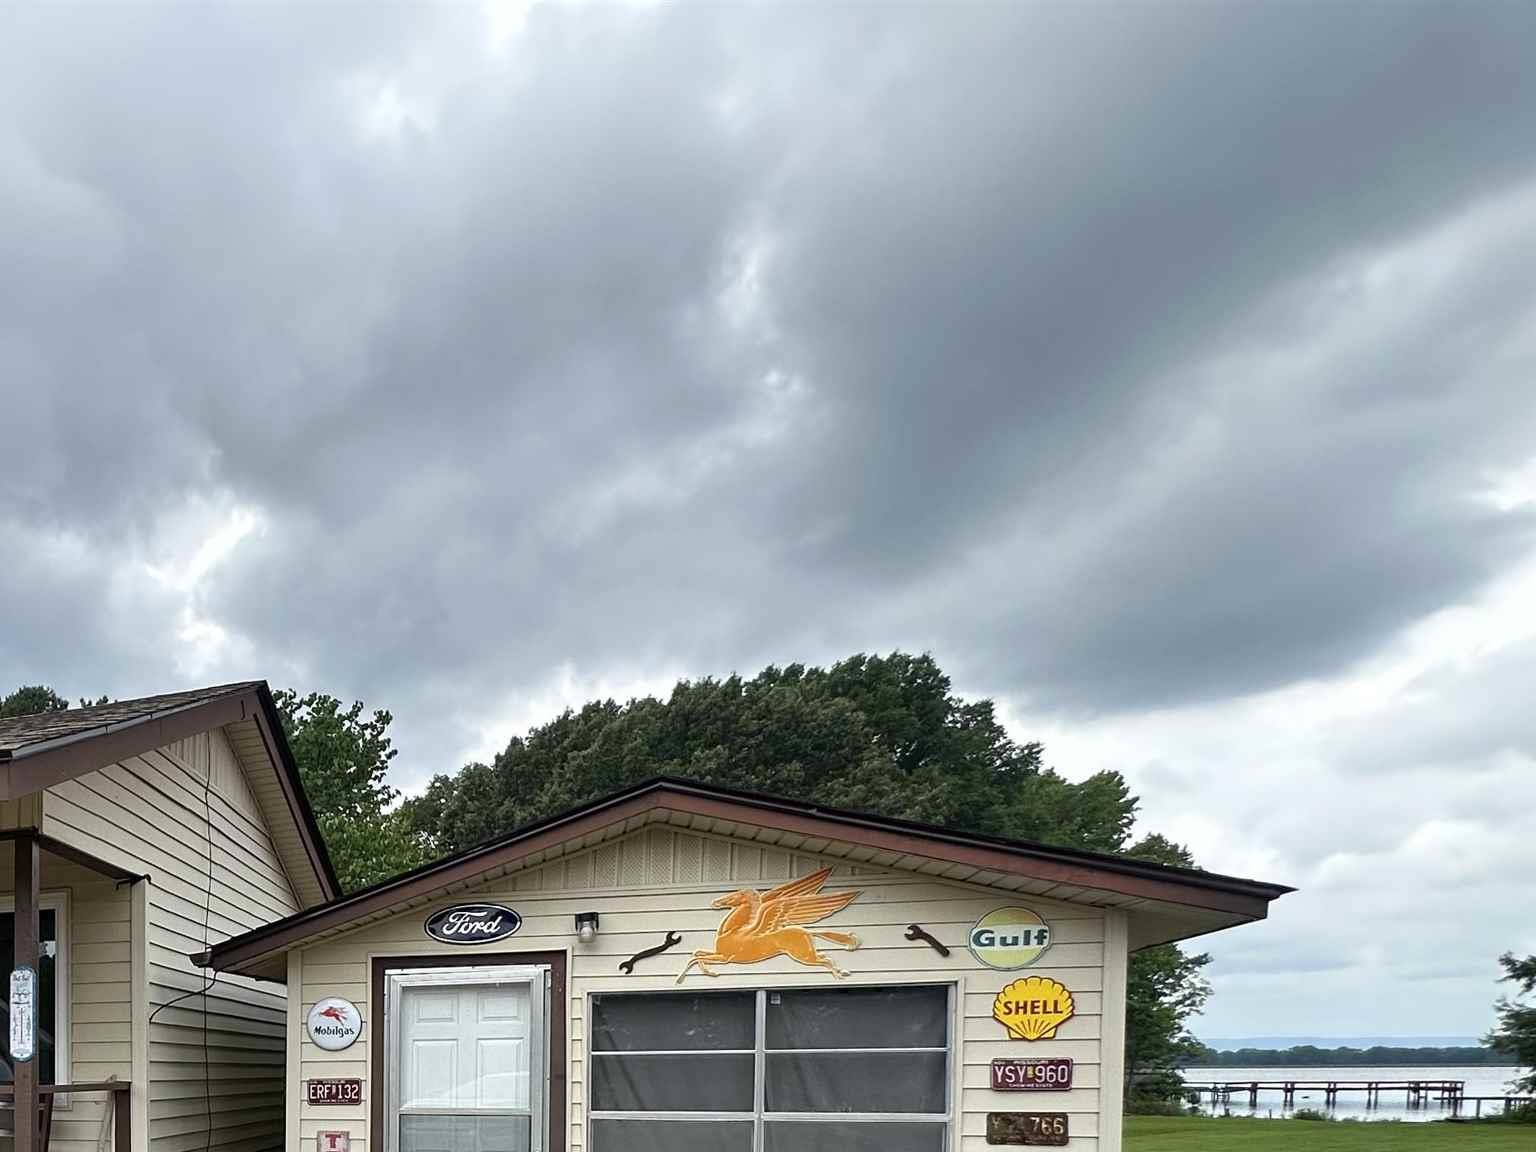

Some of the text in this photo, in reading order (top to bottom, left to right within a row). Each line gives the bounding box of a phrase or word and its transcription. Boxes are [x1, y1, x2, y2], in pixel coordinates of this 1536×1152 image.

[442, 911, 504, 935] Ford
[972, 928, 1049, 947] Gulf
[1002, 1000, 1064, 1016] SHELL
[313, 1025, 355, 1038] Mobilgas
[1035, 1065, 1069, 1083] 960
